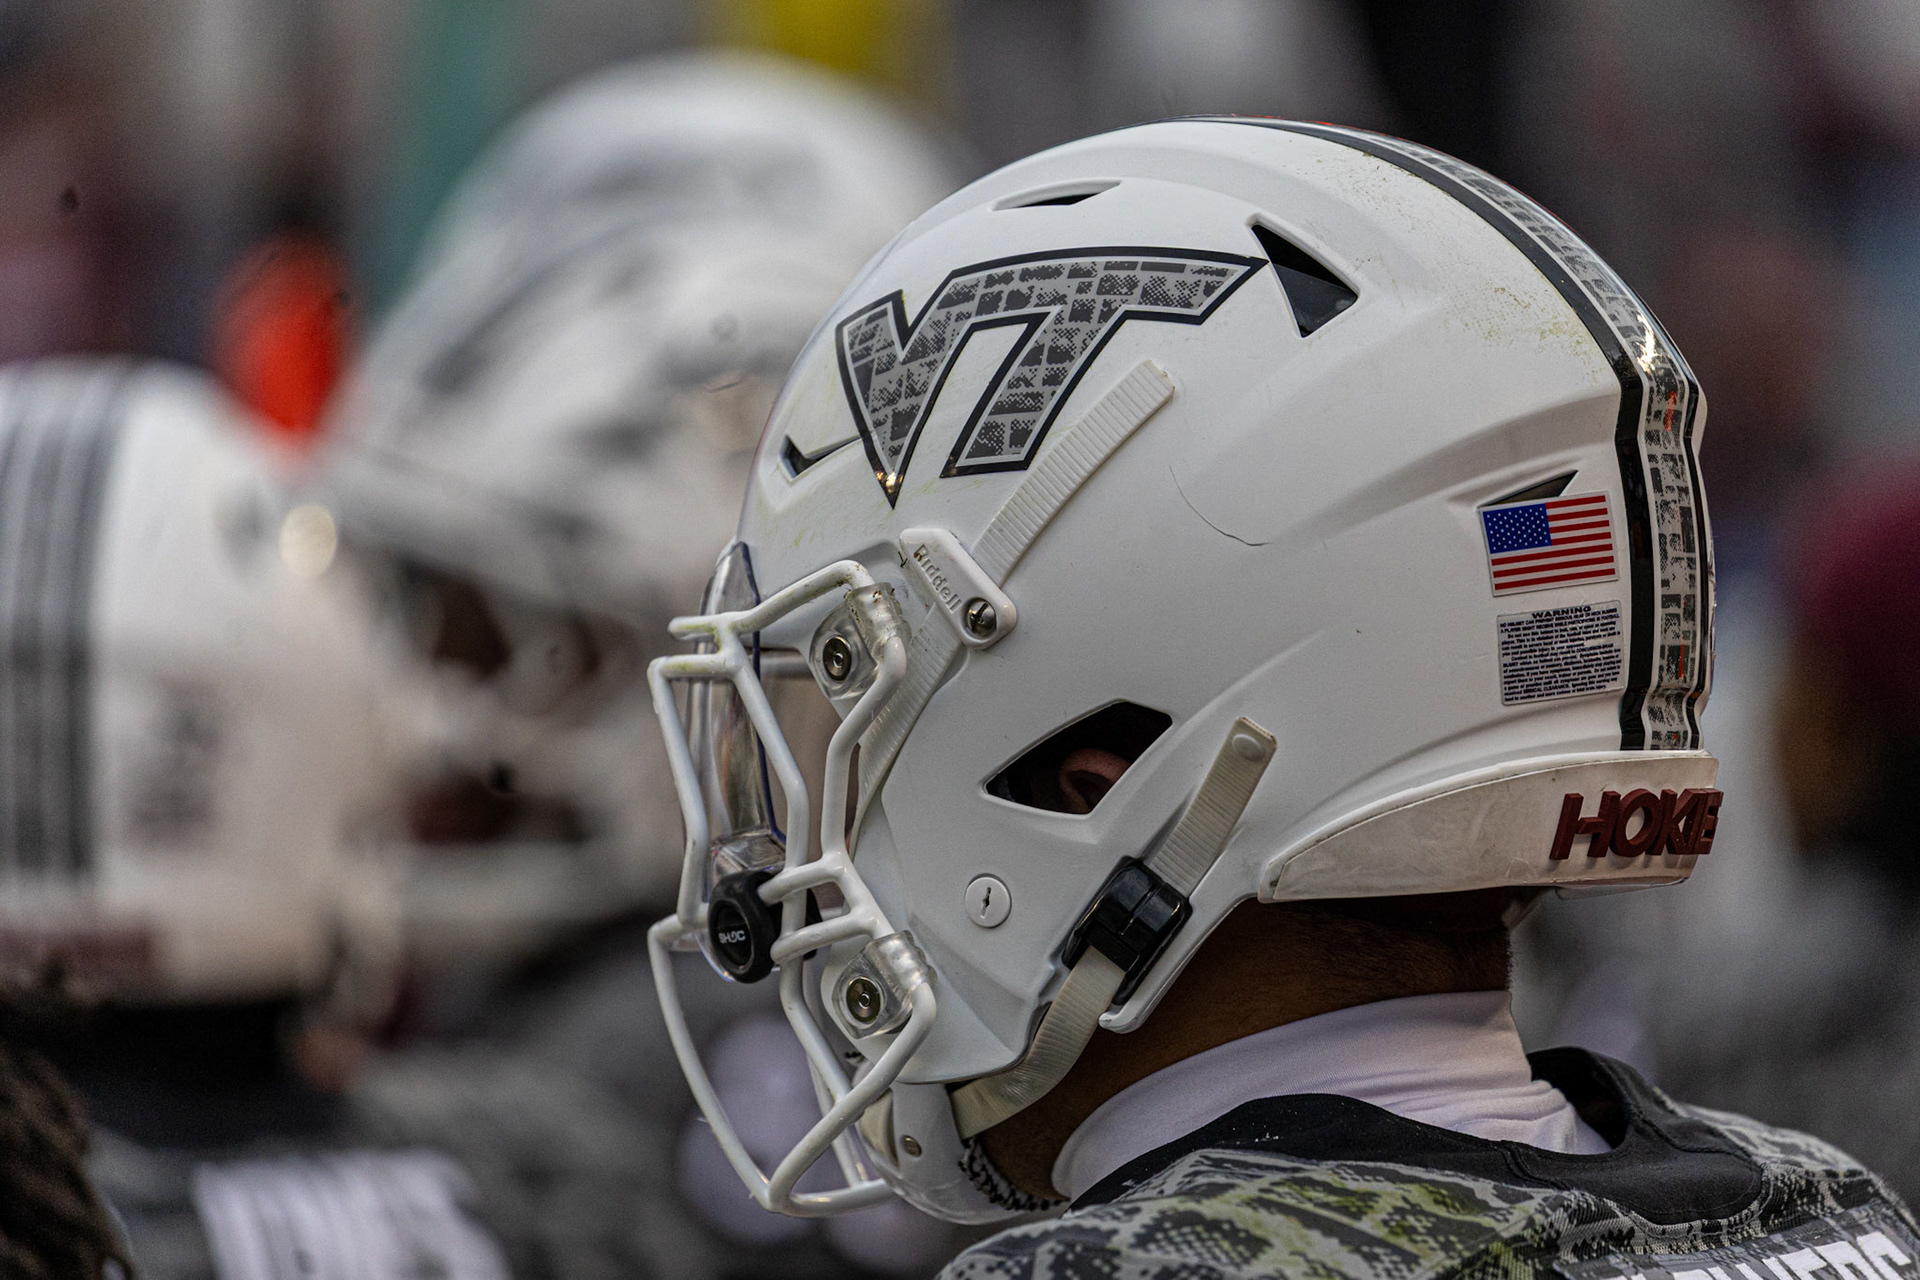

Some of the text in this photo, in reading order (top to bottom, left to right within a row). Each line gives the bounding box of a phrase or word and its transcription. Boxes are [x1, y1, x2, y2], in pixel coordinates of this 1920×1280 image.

[913, 544, 962, 614] Riddell
[1532, 606, 1591, 619] WARNING
[1549, 788, 1724, 860] HOKIE
